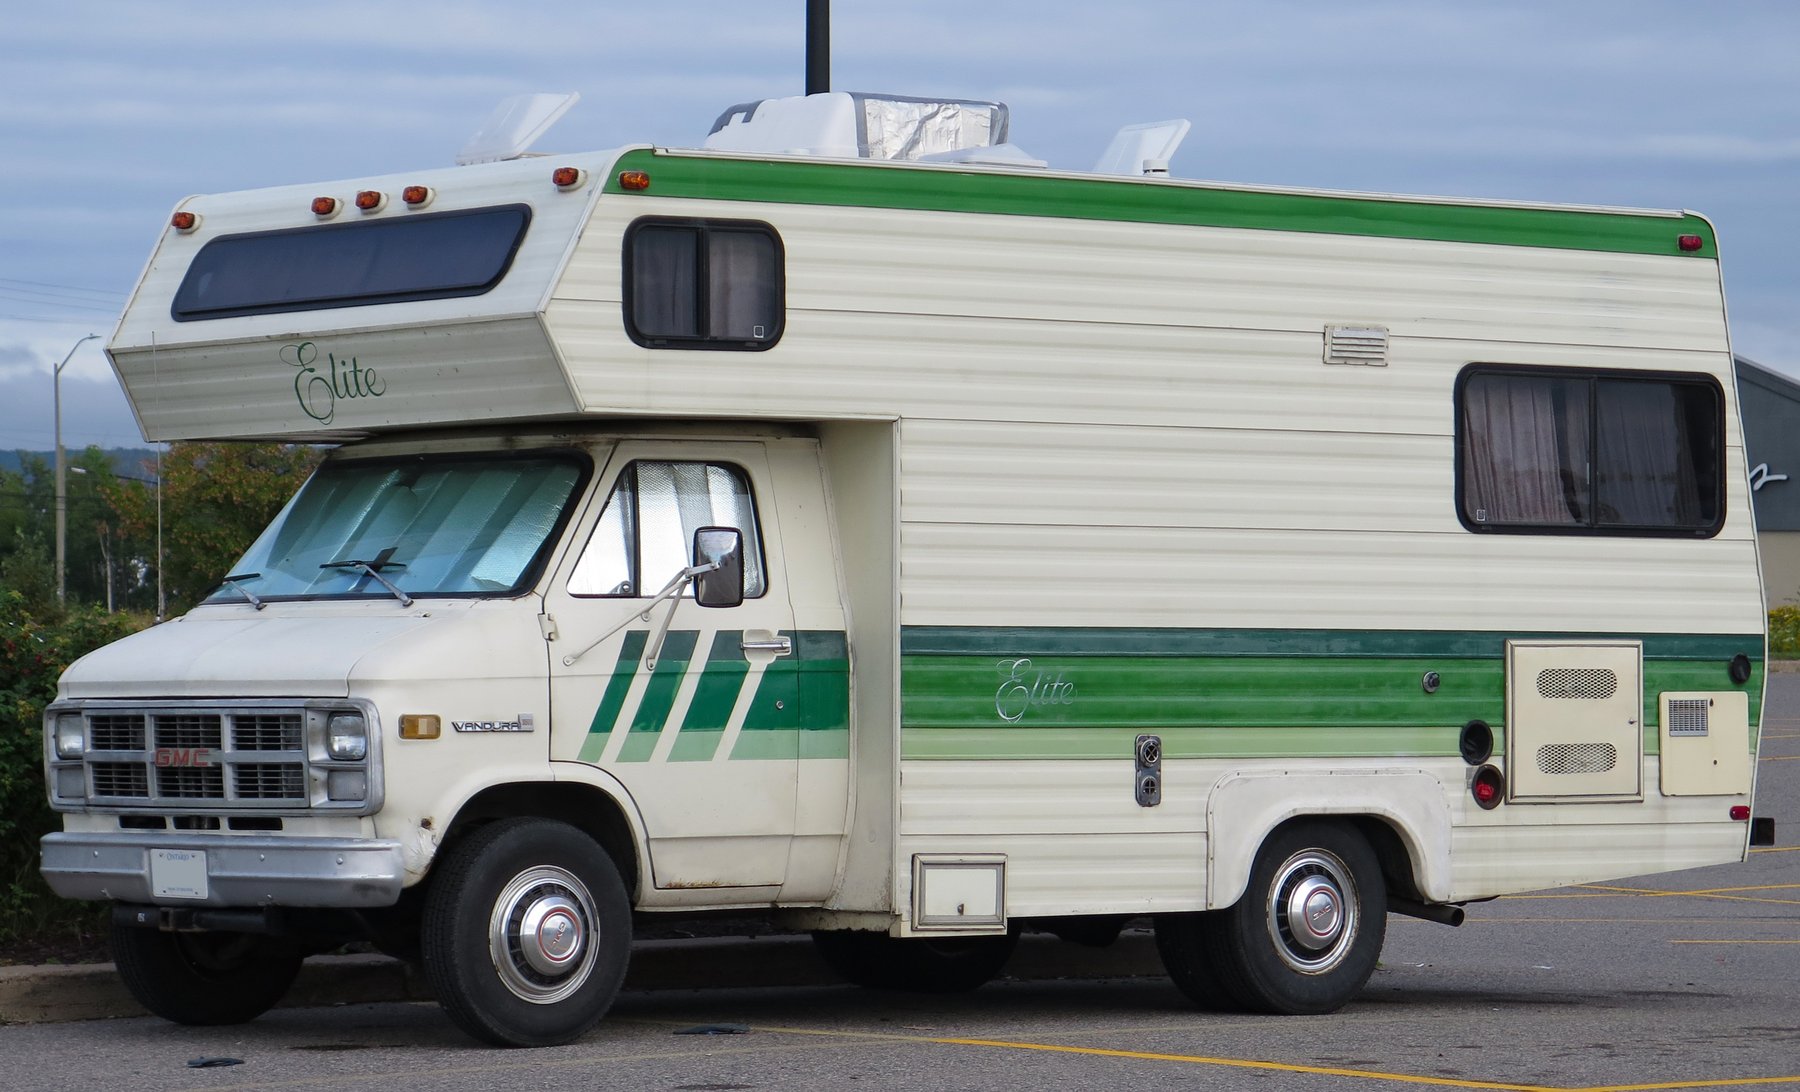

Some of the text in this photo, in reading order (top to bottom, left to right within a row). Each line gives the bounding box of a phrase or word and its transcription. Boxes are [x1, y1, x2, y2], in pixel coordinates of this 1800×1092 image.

[279, 342, 386, 425] Elite
[996, 658, 1078, 724] Elite
[453, 721, 520, 731] VANDURA
[155, 747, 209, 767] GMC
